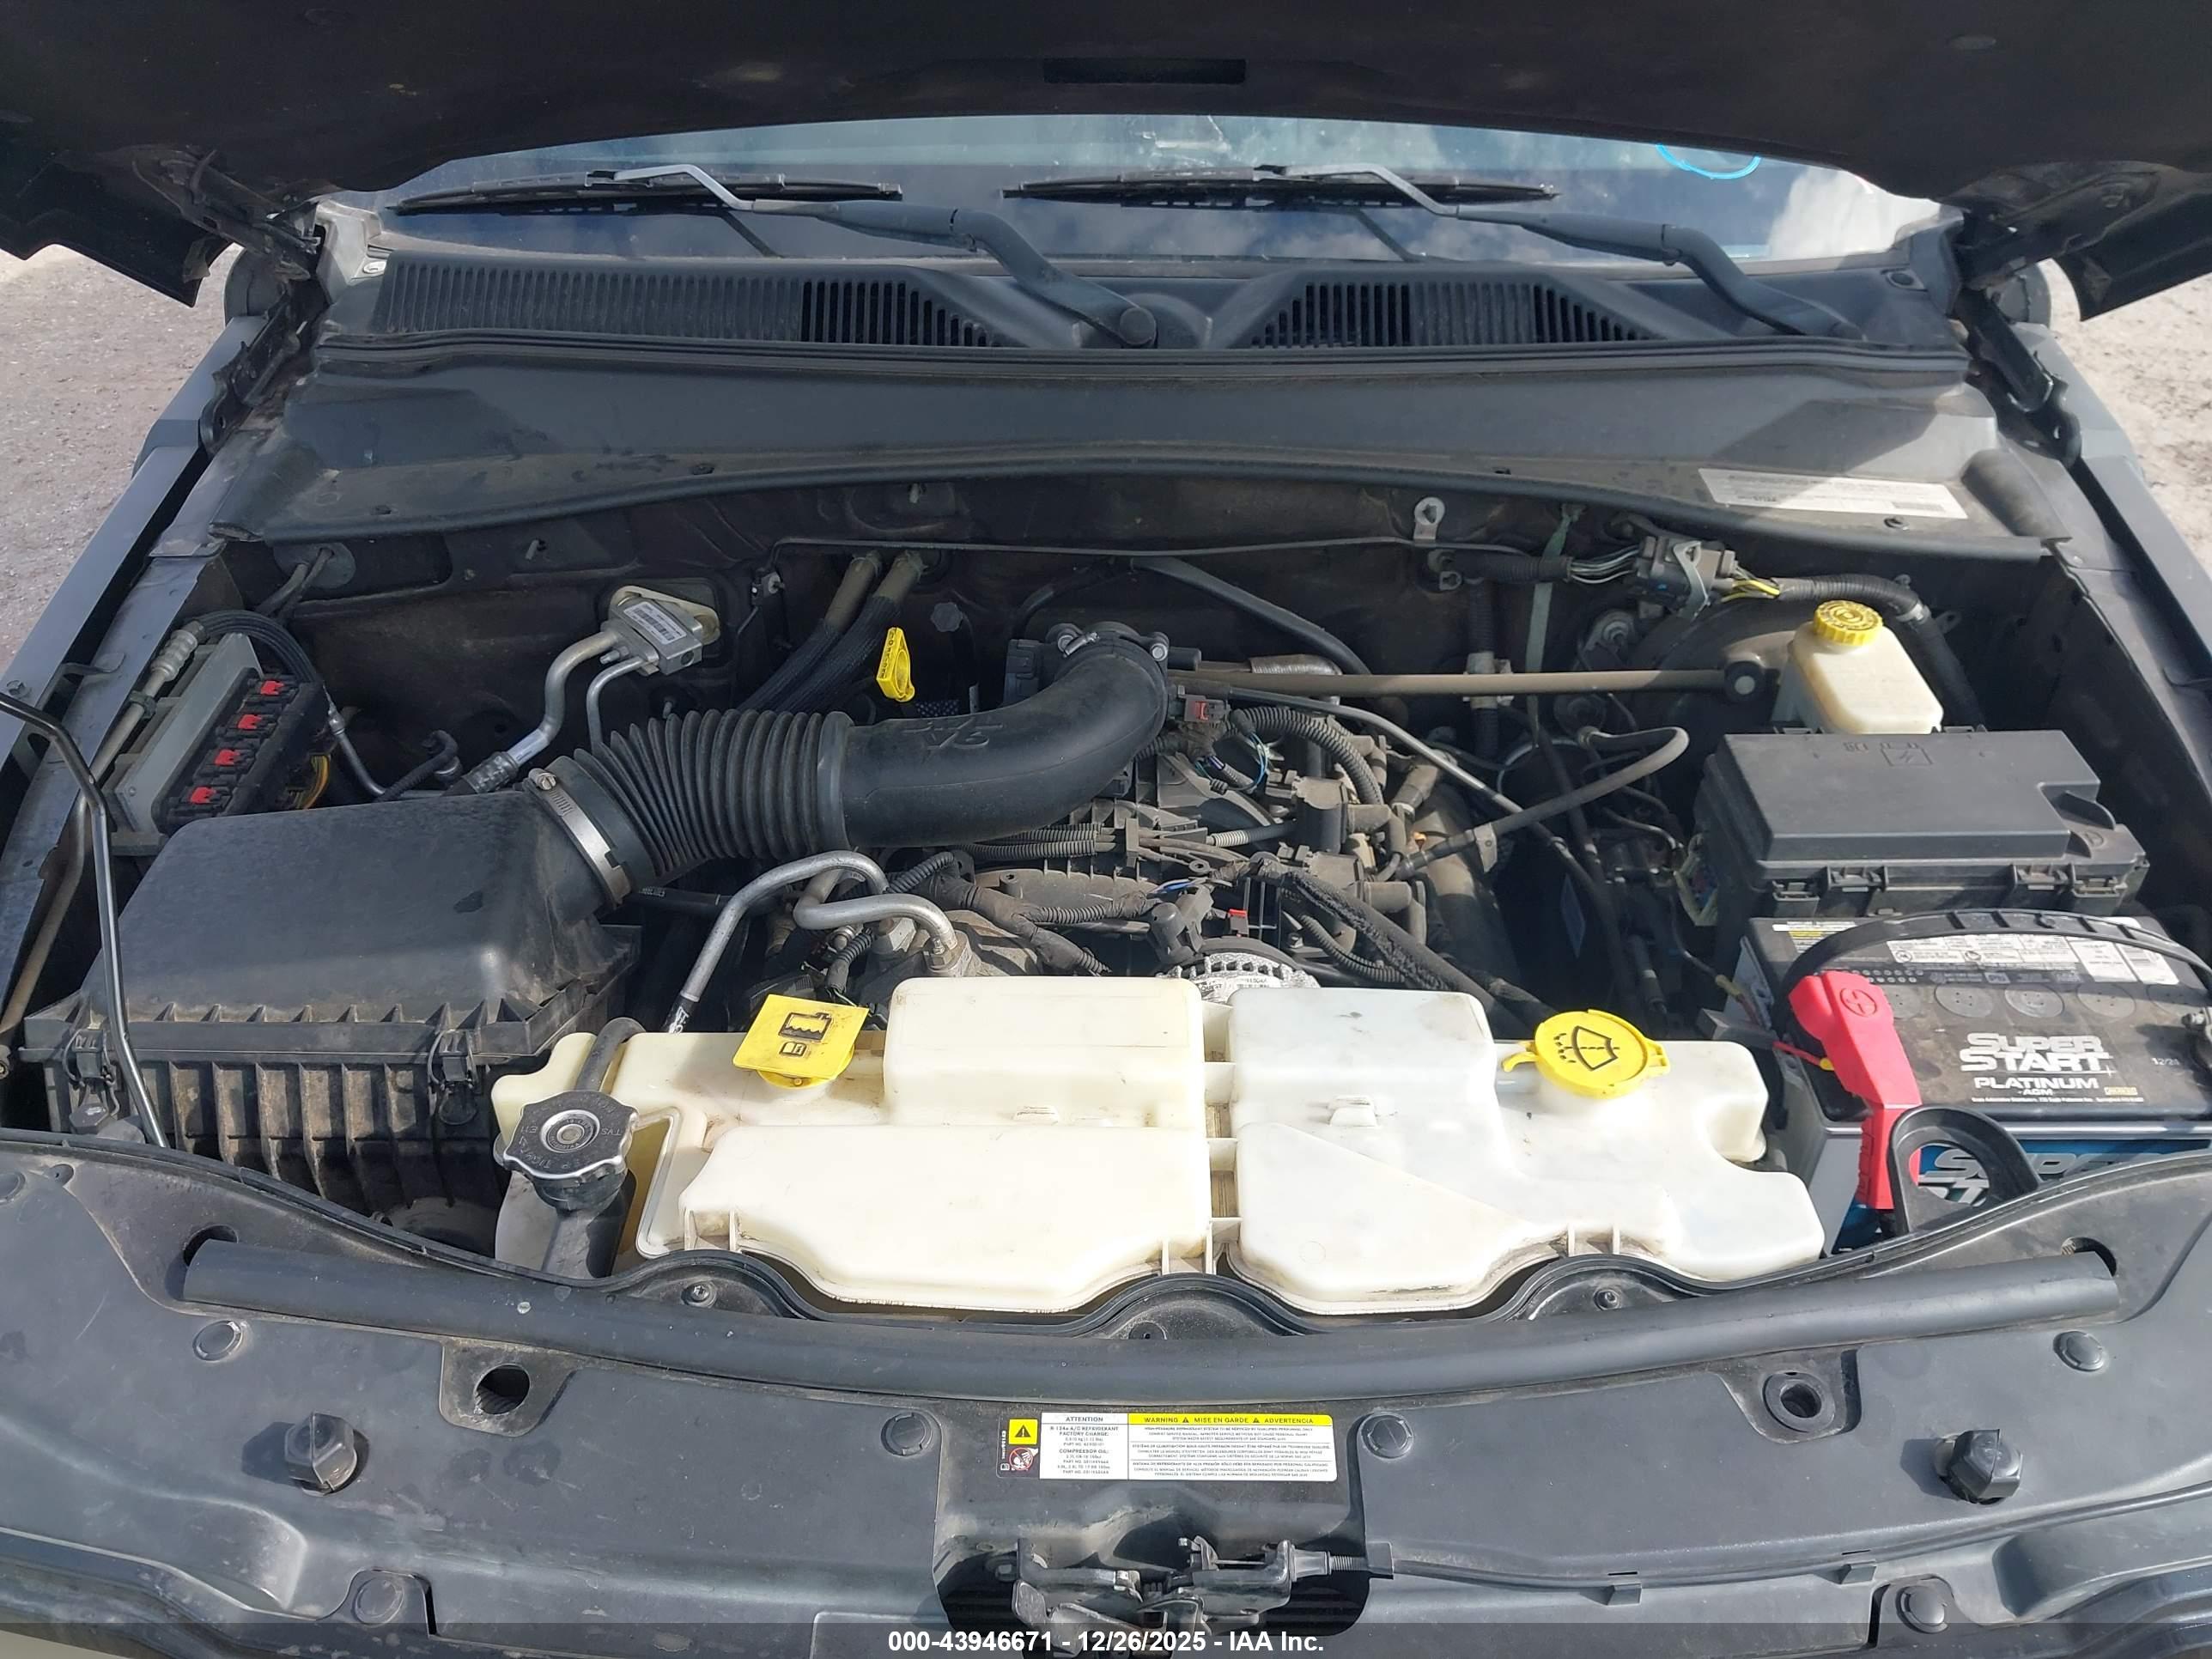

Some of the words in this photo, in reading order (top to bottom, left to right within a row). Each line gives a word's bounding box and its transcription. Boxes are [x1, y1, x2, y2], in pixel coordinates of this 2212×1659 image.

[1966, 1032, 2105, 1054] SUPER
[1959, 1048, 2114, 1073] START
[1973, 1077, 2100, 1089] PLATINUM
